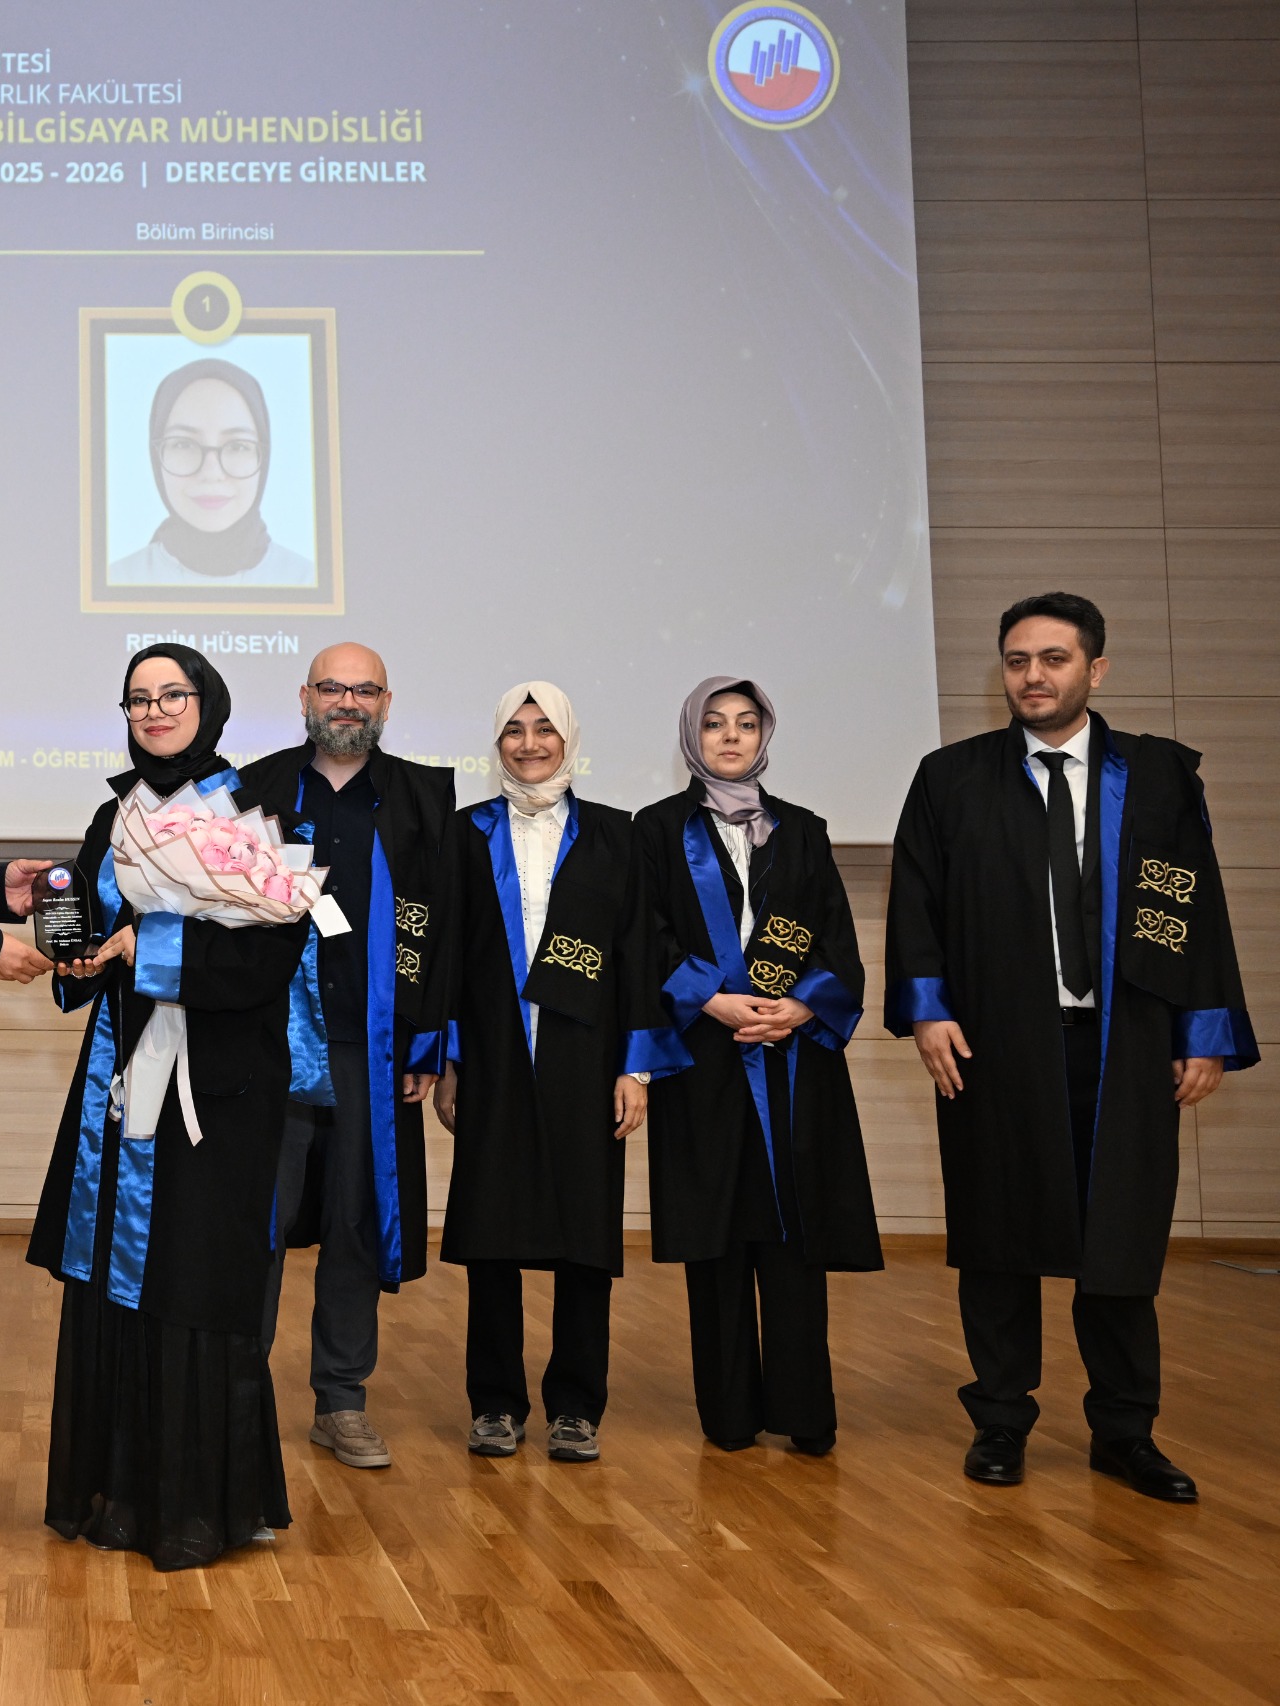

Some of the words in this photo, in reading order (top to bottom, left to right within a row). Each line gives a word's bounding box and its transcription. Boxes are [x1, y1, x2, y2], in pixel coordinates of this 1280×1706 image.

[58, 78, 183, 105] FAKÜLTESİ
[180, 109, 423, 143] MÜHENDİSLİĞİ
[65, 161, 124, 183] 2026
[166, 161, 292, 183] DERECEYE
[299, 156, 427, 183] GİRENLER
[136, 222, 196, 241] Bölüm
[201, 222, 274, 241] Birincisi
[202, 295, 210, 313] 1
[202, 630, 299, 654] HÜSEYİN
[33, 746, 126, 769] ÖĞRETİM
